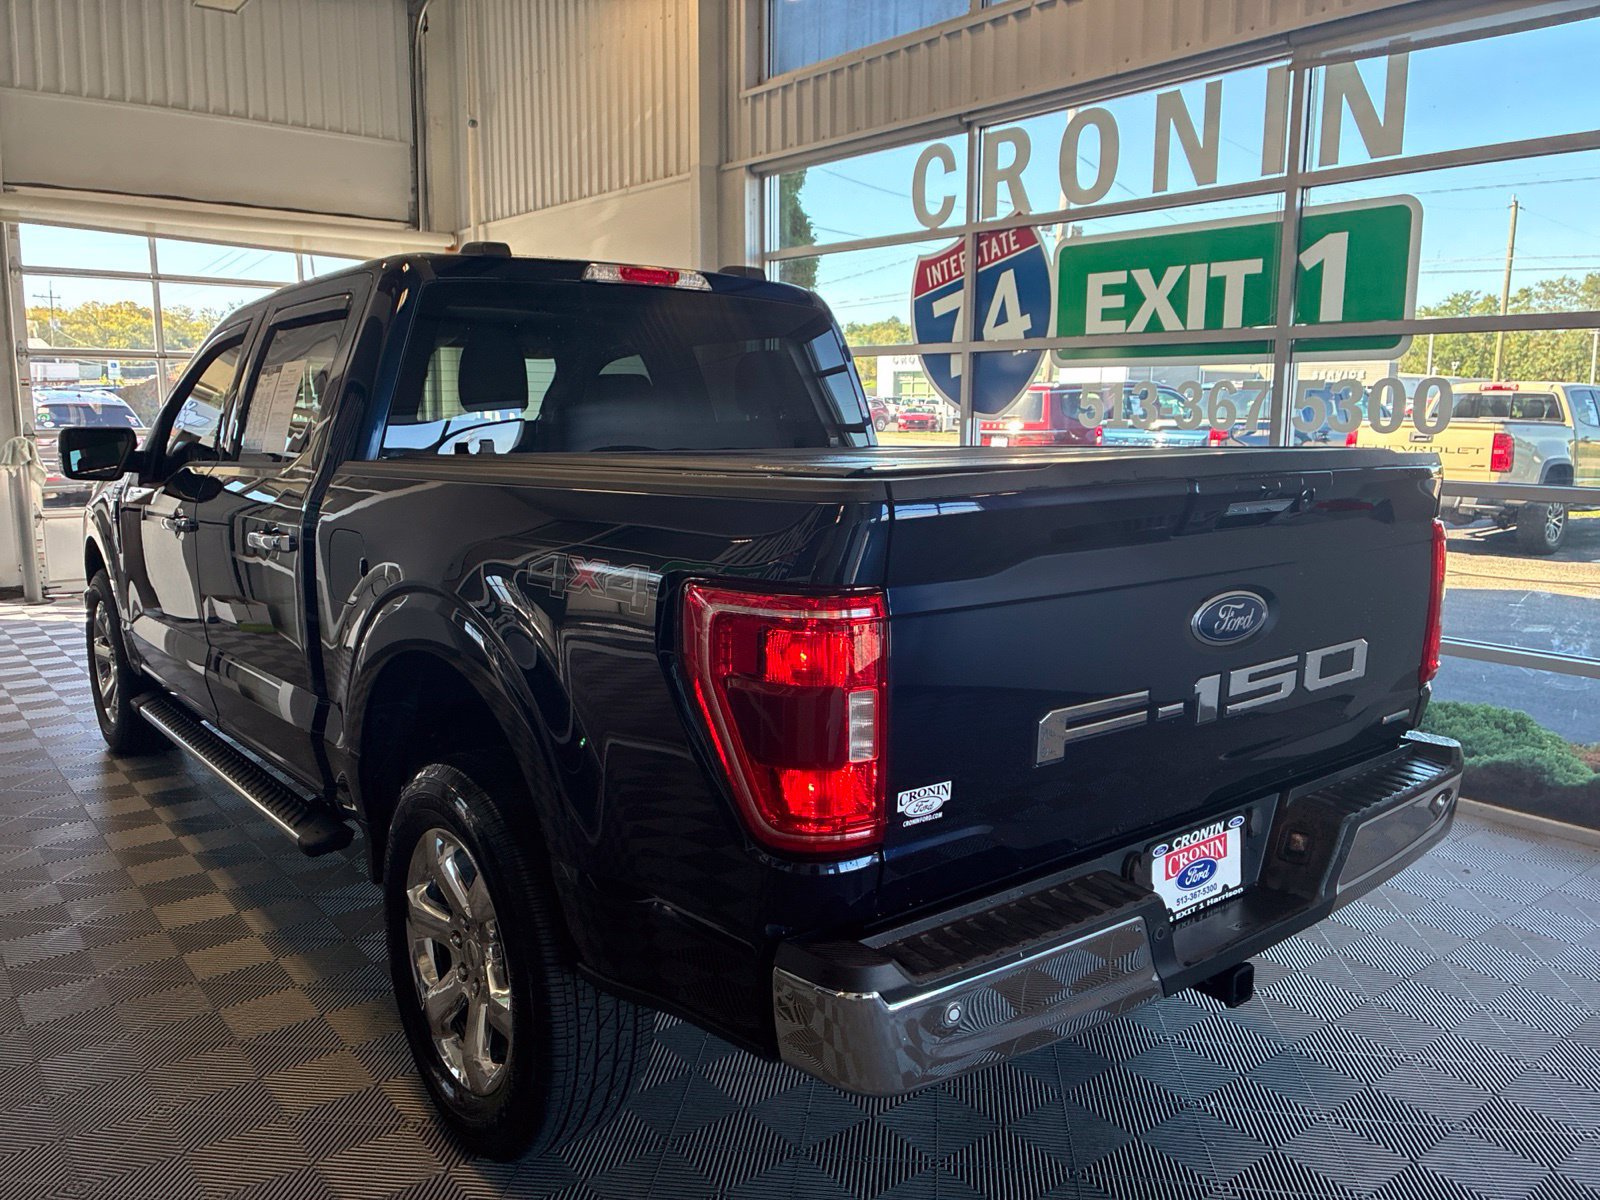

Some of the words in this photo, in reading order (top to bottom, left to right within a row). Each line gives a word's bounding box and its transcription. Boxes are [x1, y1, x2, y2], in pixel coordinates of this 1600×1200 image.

[912, 53, 1410, 229] CRONIN
[1085, 258, 1263, 335] EXIT
[1299, 231, 1349, 323] 1
[932, 268, 1032, 379] 74
[1214, 603, 1255, 635] Ford
[1035, 638, 1368, 766] F-150
[899, 783, 950, 807] CRONIN
[1172, 821, 1225, 852] CRONIN
[1168, 836, 1225, 877] CRONIN
[1185, 863, 1210, 885] Ford
[1175, 905, 1198, 920] EXIT
[1206, 887, 1243, 905] Harrison
[1176, 882, 1218, 907] 513-367-5300
